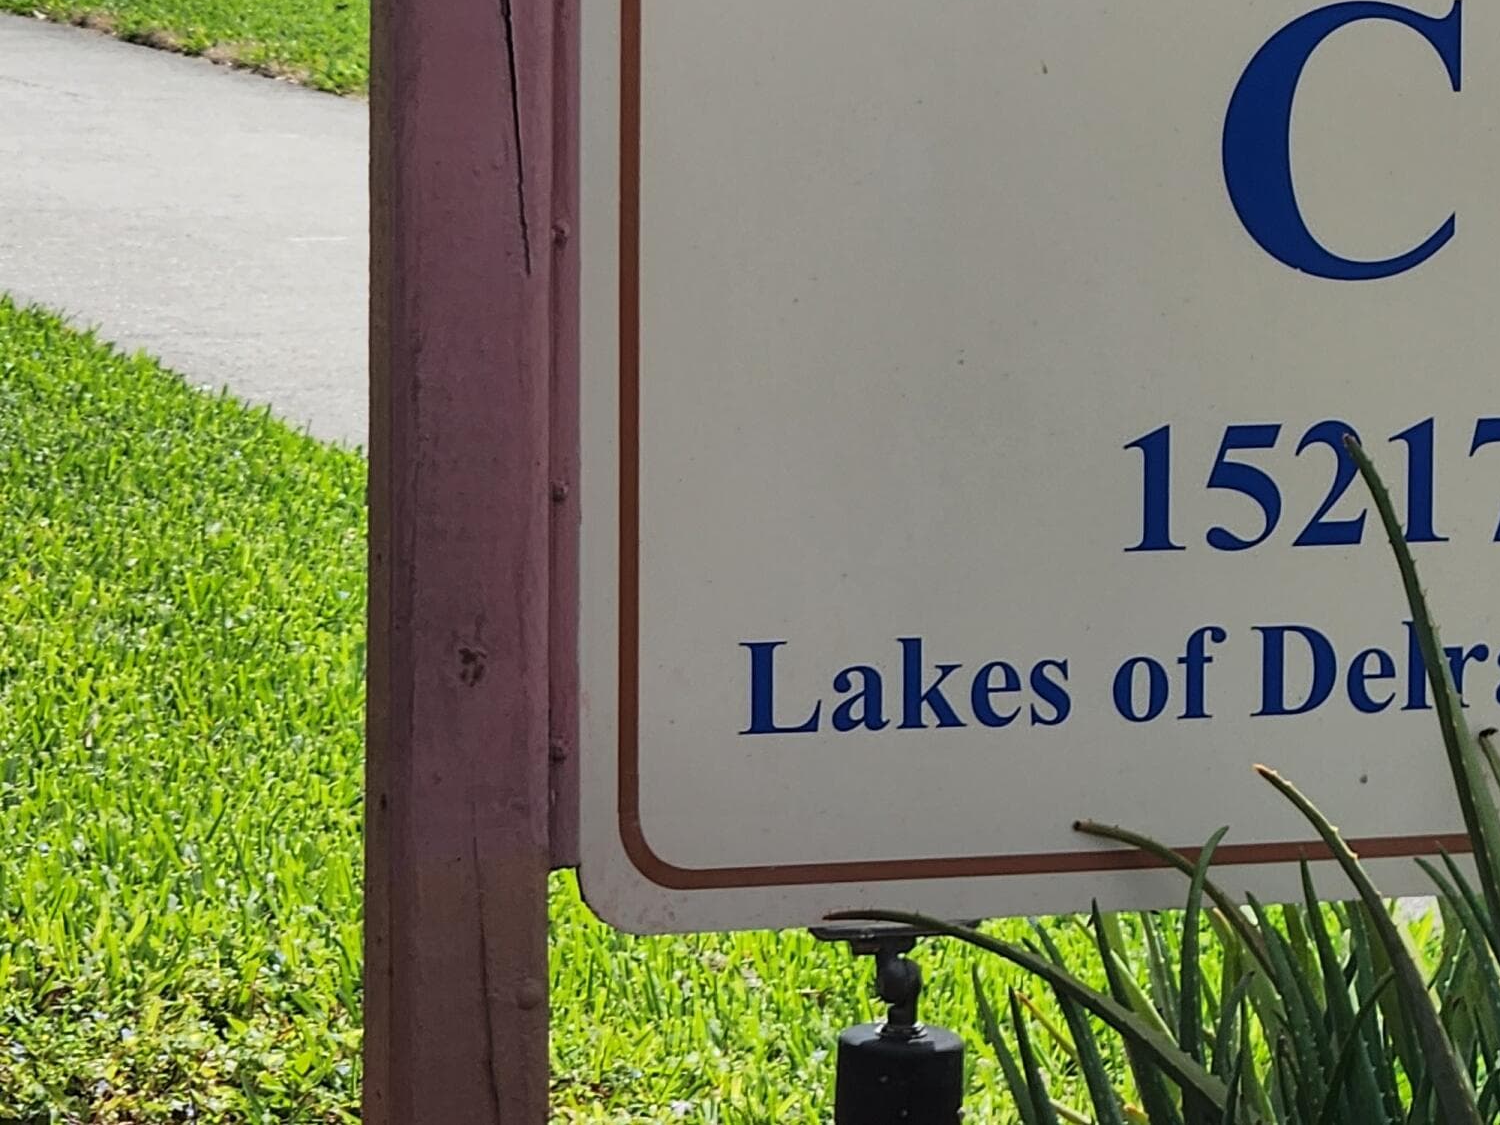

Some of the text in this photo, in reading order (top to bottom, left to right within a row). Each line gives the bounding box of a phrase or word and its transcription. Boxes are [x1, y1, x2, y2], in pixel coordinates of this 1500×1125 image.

[1222, 0, 1465, 280] C
[739, 639, 1069, 733] Lakes
[1113, 626, 1226, 721] of
